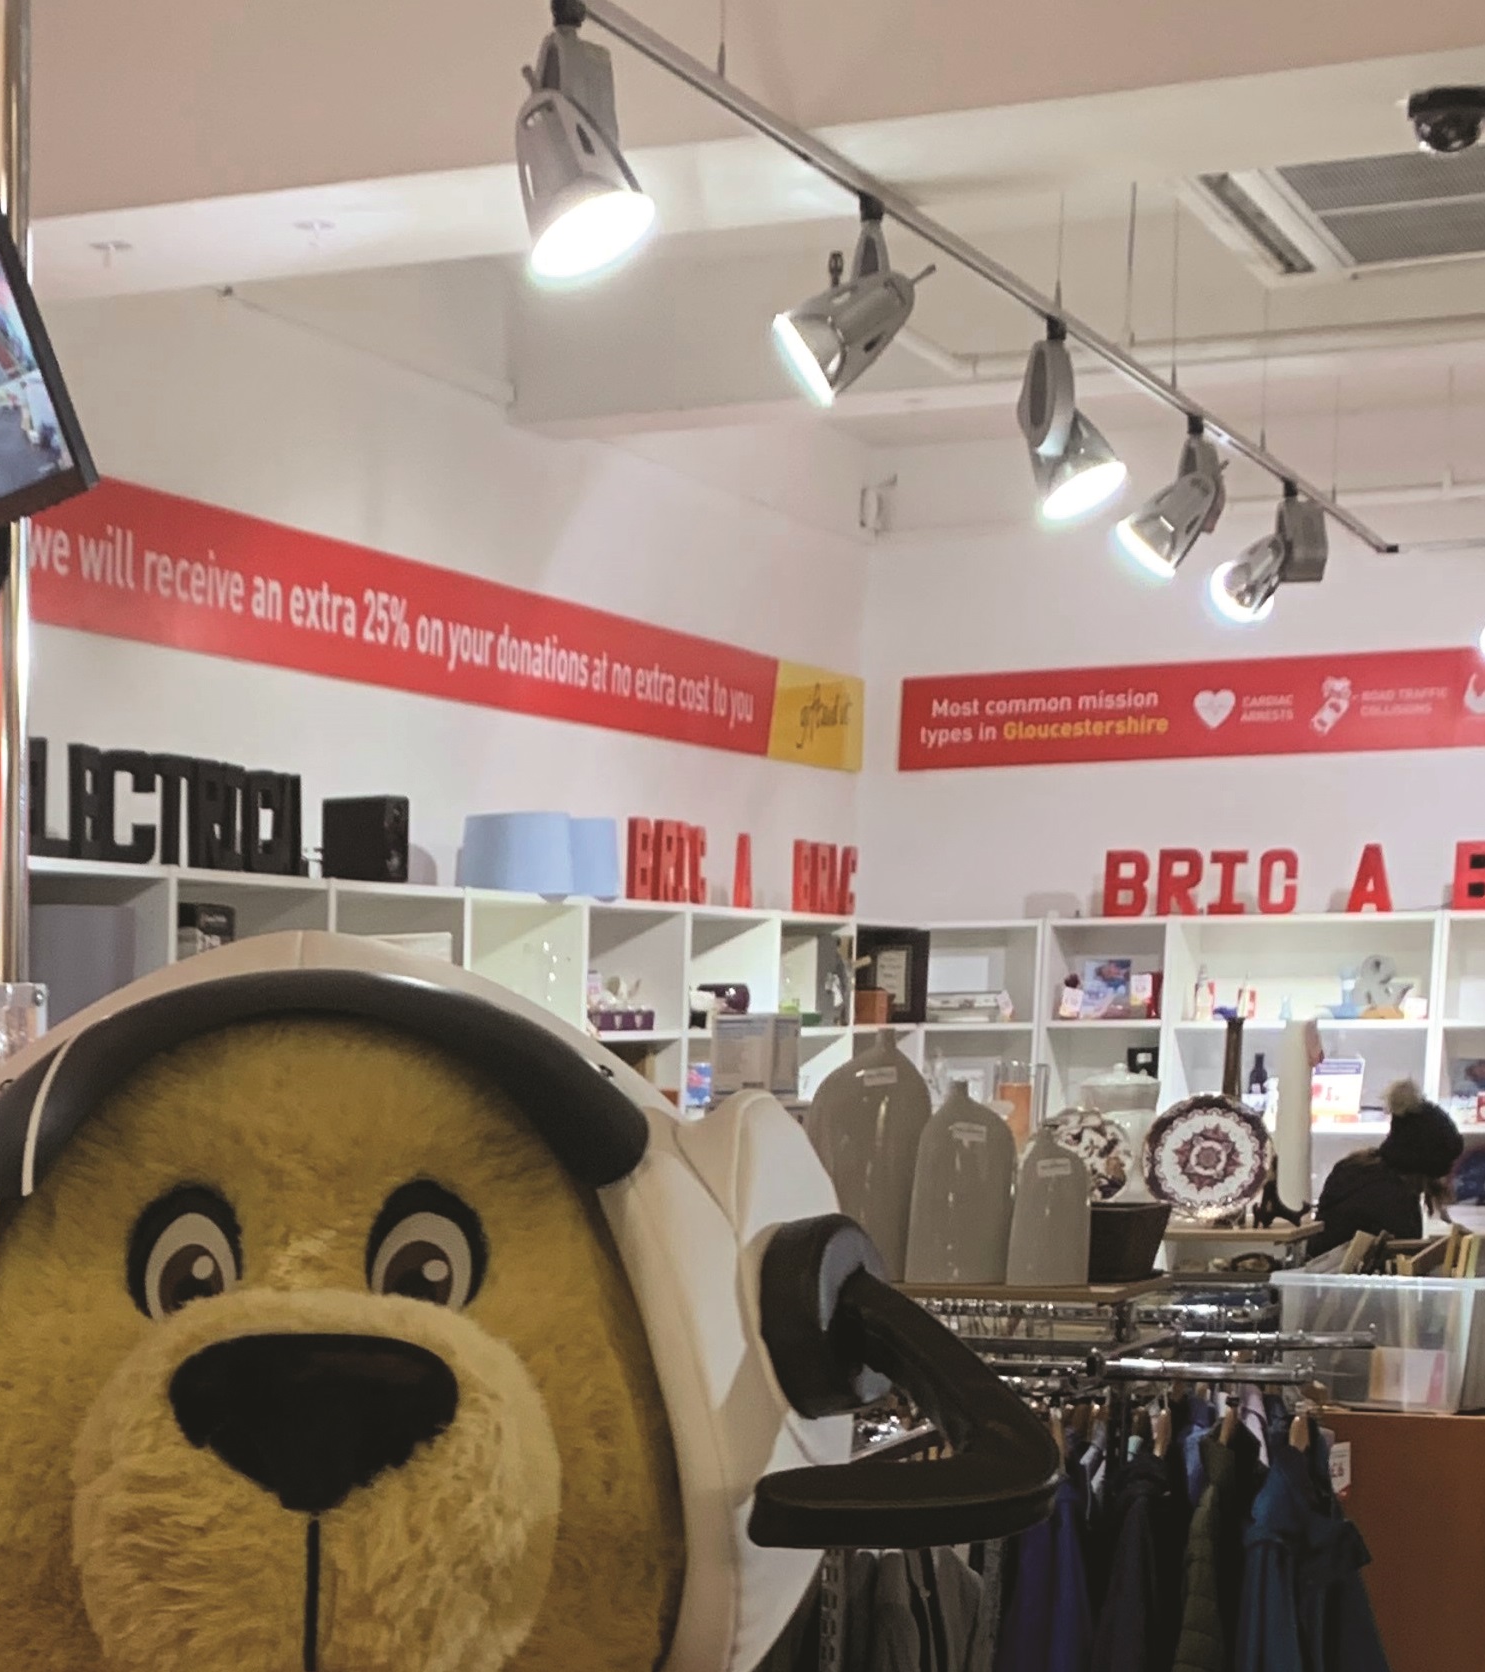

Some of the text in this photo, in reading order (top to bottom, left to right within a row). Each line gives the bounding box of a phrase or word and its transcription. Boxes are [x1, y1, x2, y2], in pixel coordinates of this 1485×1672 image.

[29, 525, 71, 576] we
[77, 523, 136, 590] will
[143, 548, 245, 615] receive
[250, 574, 283, 623] an
[289, 581, 356, 638] extra
[362, 587, 410, 650] 25%
[416, 613, 444, 658] on
[447, 619, 494, 671] your
[496, 622, 589, 684] donations
[591, 652, 608, 692] at
[611, 660, 632, 698] no
[635, 662, 676, 706] extra
[678, 673, 711, 714] cost
[712, 676, 728, 717] to
[728, 687, 754, 731] you
[931, 688, 1159, 718] Most common mission
[920, 713, 1169, 750] types in Gloucestershire
[1101, 847, 1299, 917] BRIC
[1344, 842, 1394, 914] A
